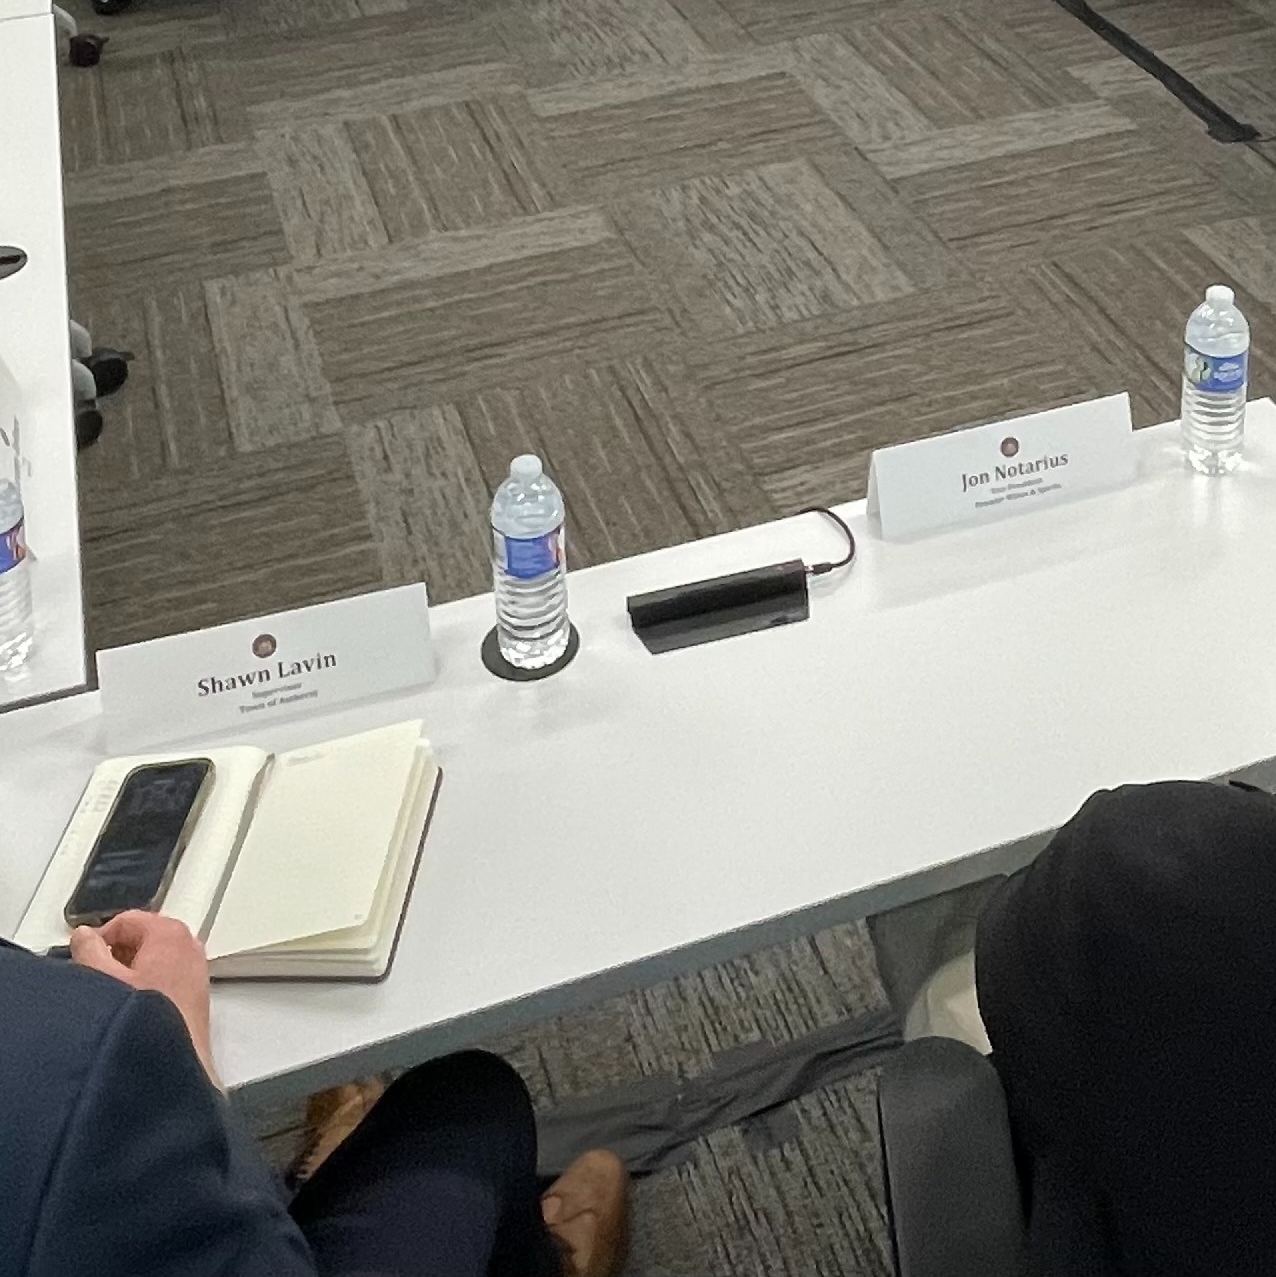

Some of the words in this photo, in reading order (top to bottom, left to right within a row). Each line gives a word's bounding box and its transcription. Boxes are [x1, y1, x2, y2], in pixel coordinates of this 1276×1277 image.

[962, 472, 990, 493] Jon
[995, 453, 1069, 482] Notarius
[197, 668, 271, 697] Shawn
[278, 652, 337, 678] Lavin
